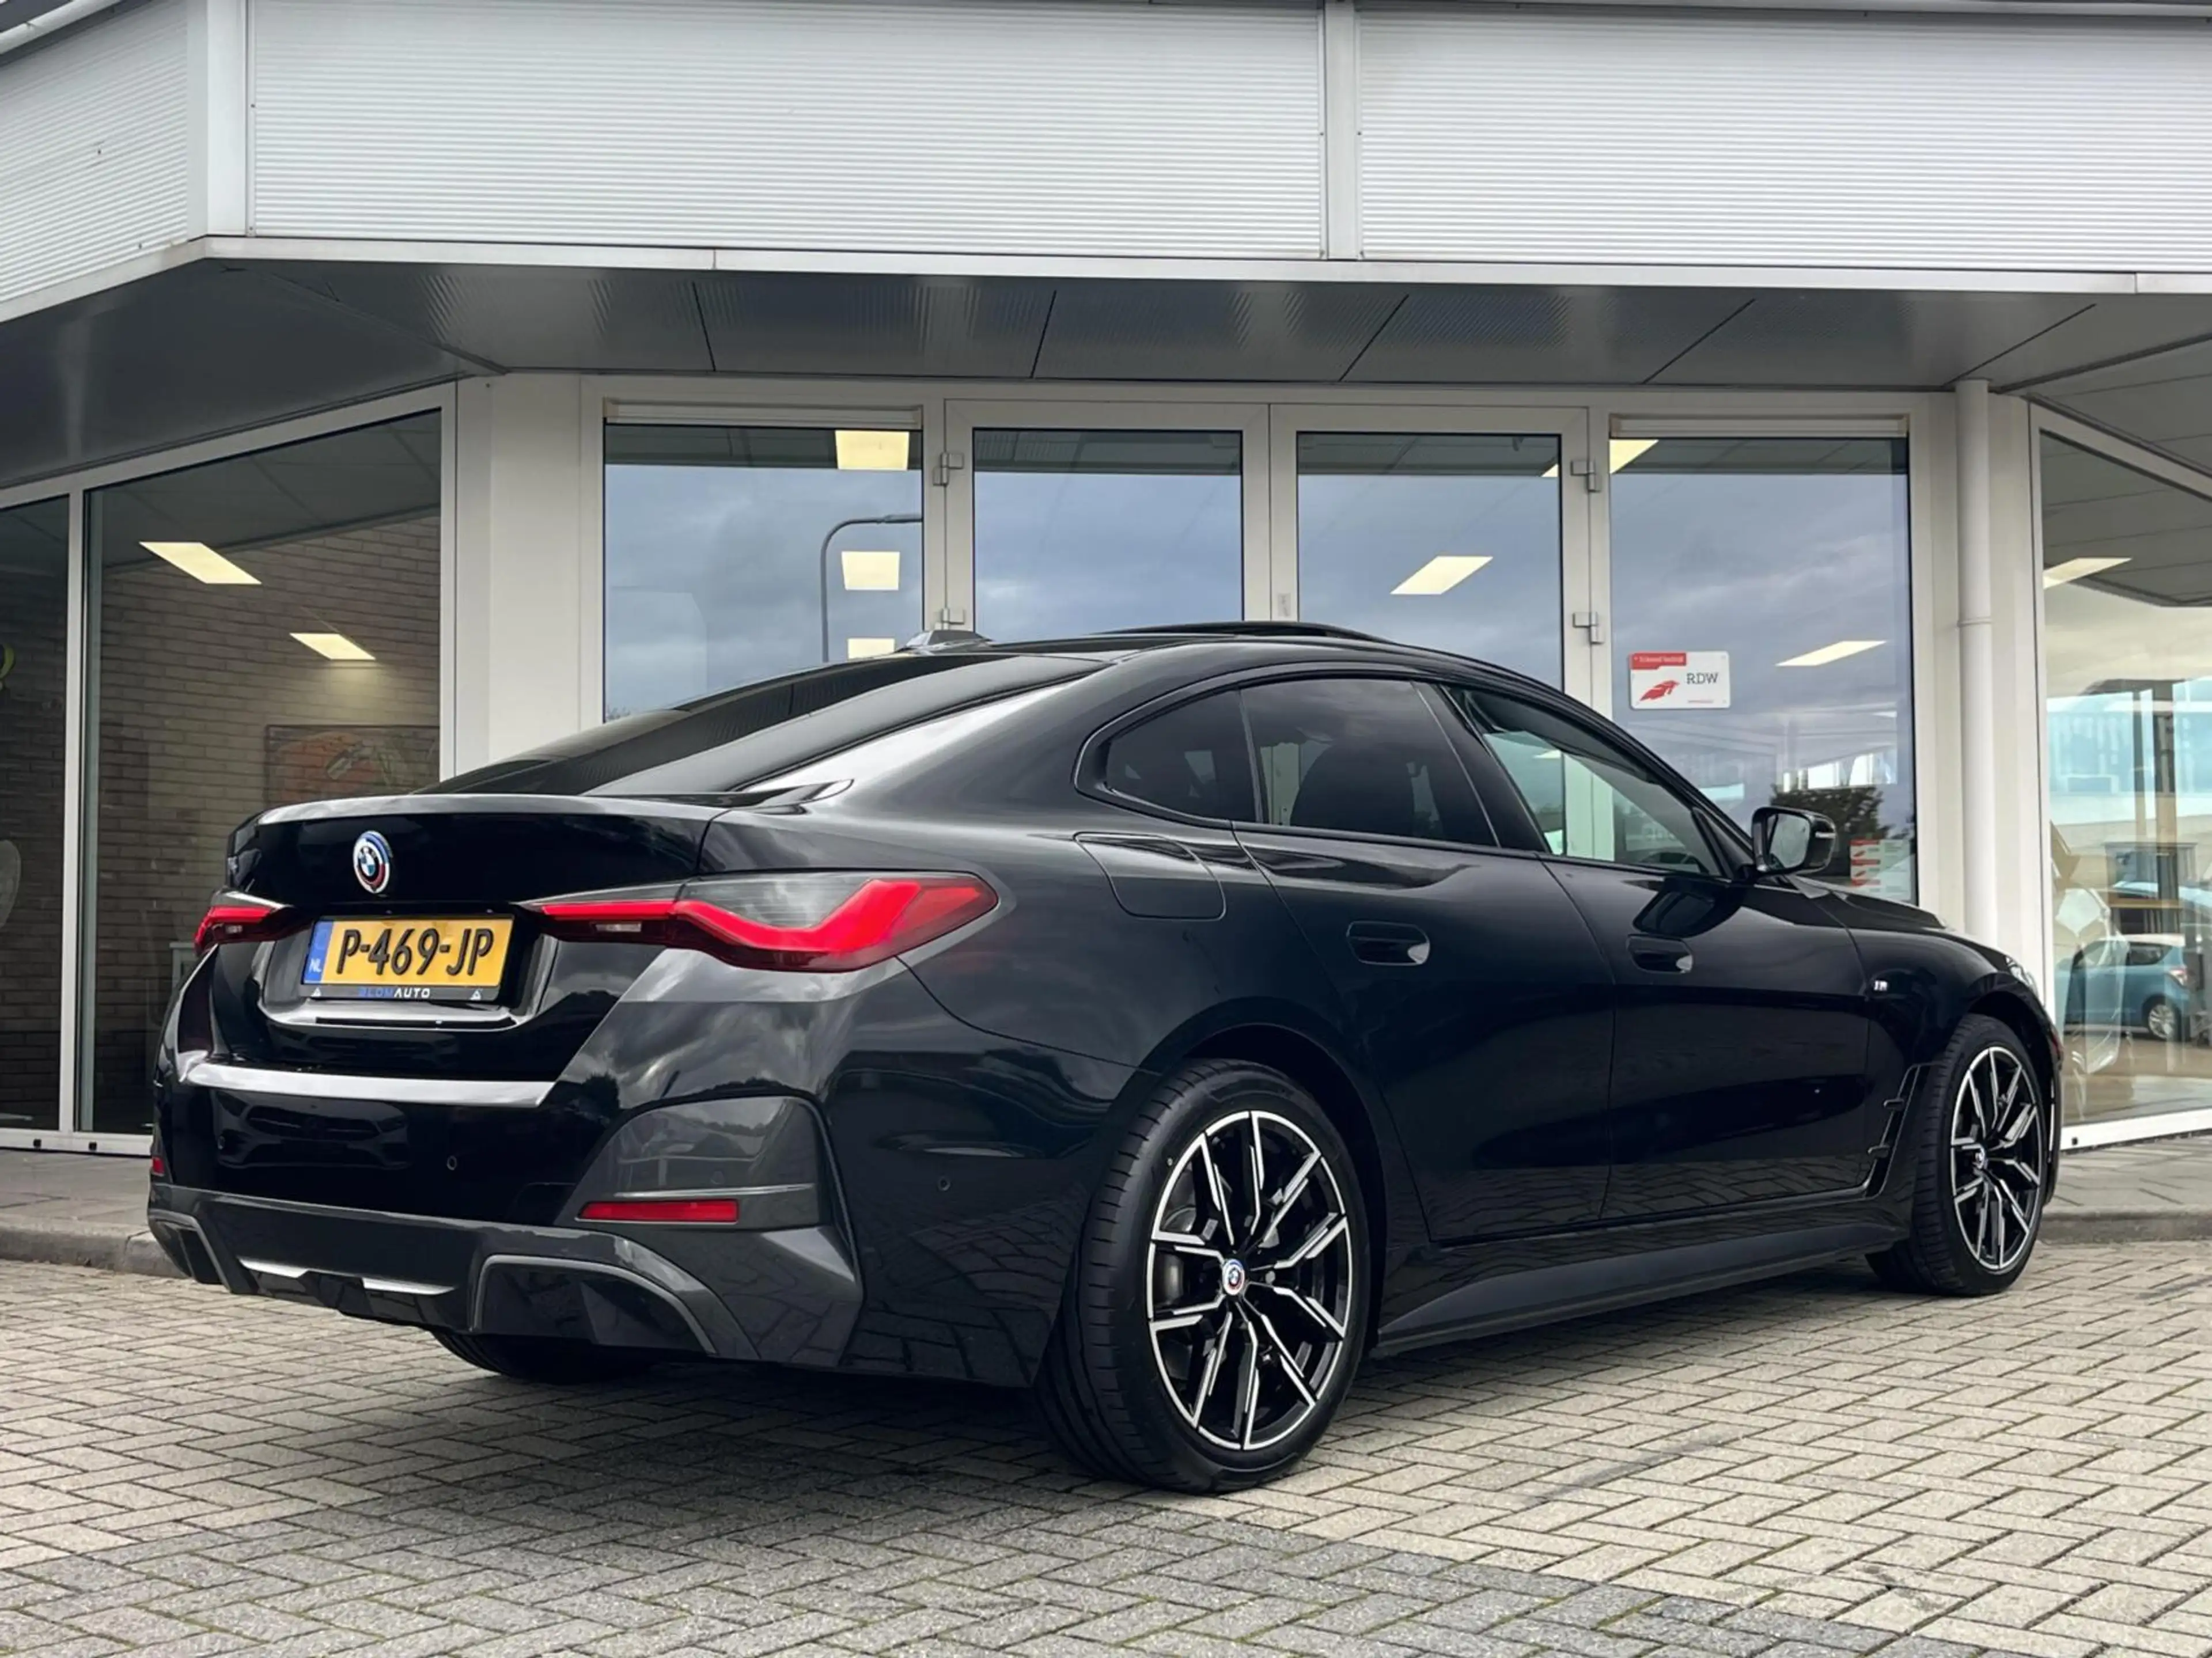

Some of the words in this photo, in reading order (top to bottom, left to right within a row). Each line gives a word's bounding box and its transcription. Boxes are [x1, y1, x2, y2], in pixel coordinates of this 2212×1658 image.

[1687, 671, 1718, 685] RDW
[336, 928, 494, 976] P-469-JP
[309, 958, 321, 973] NL
